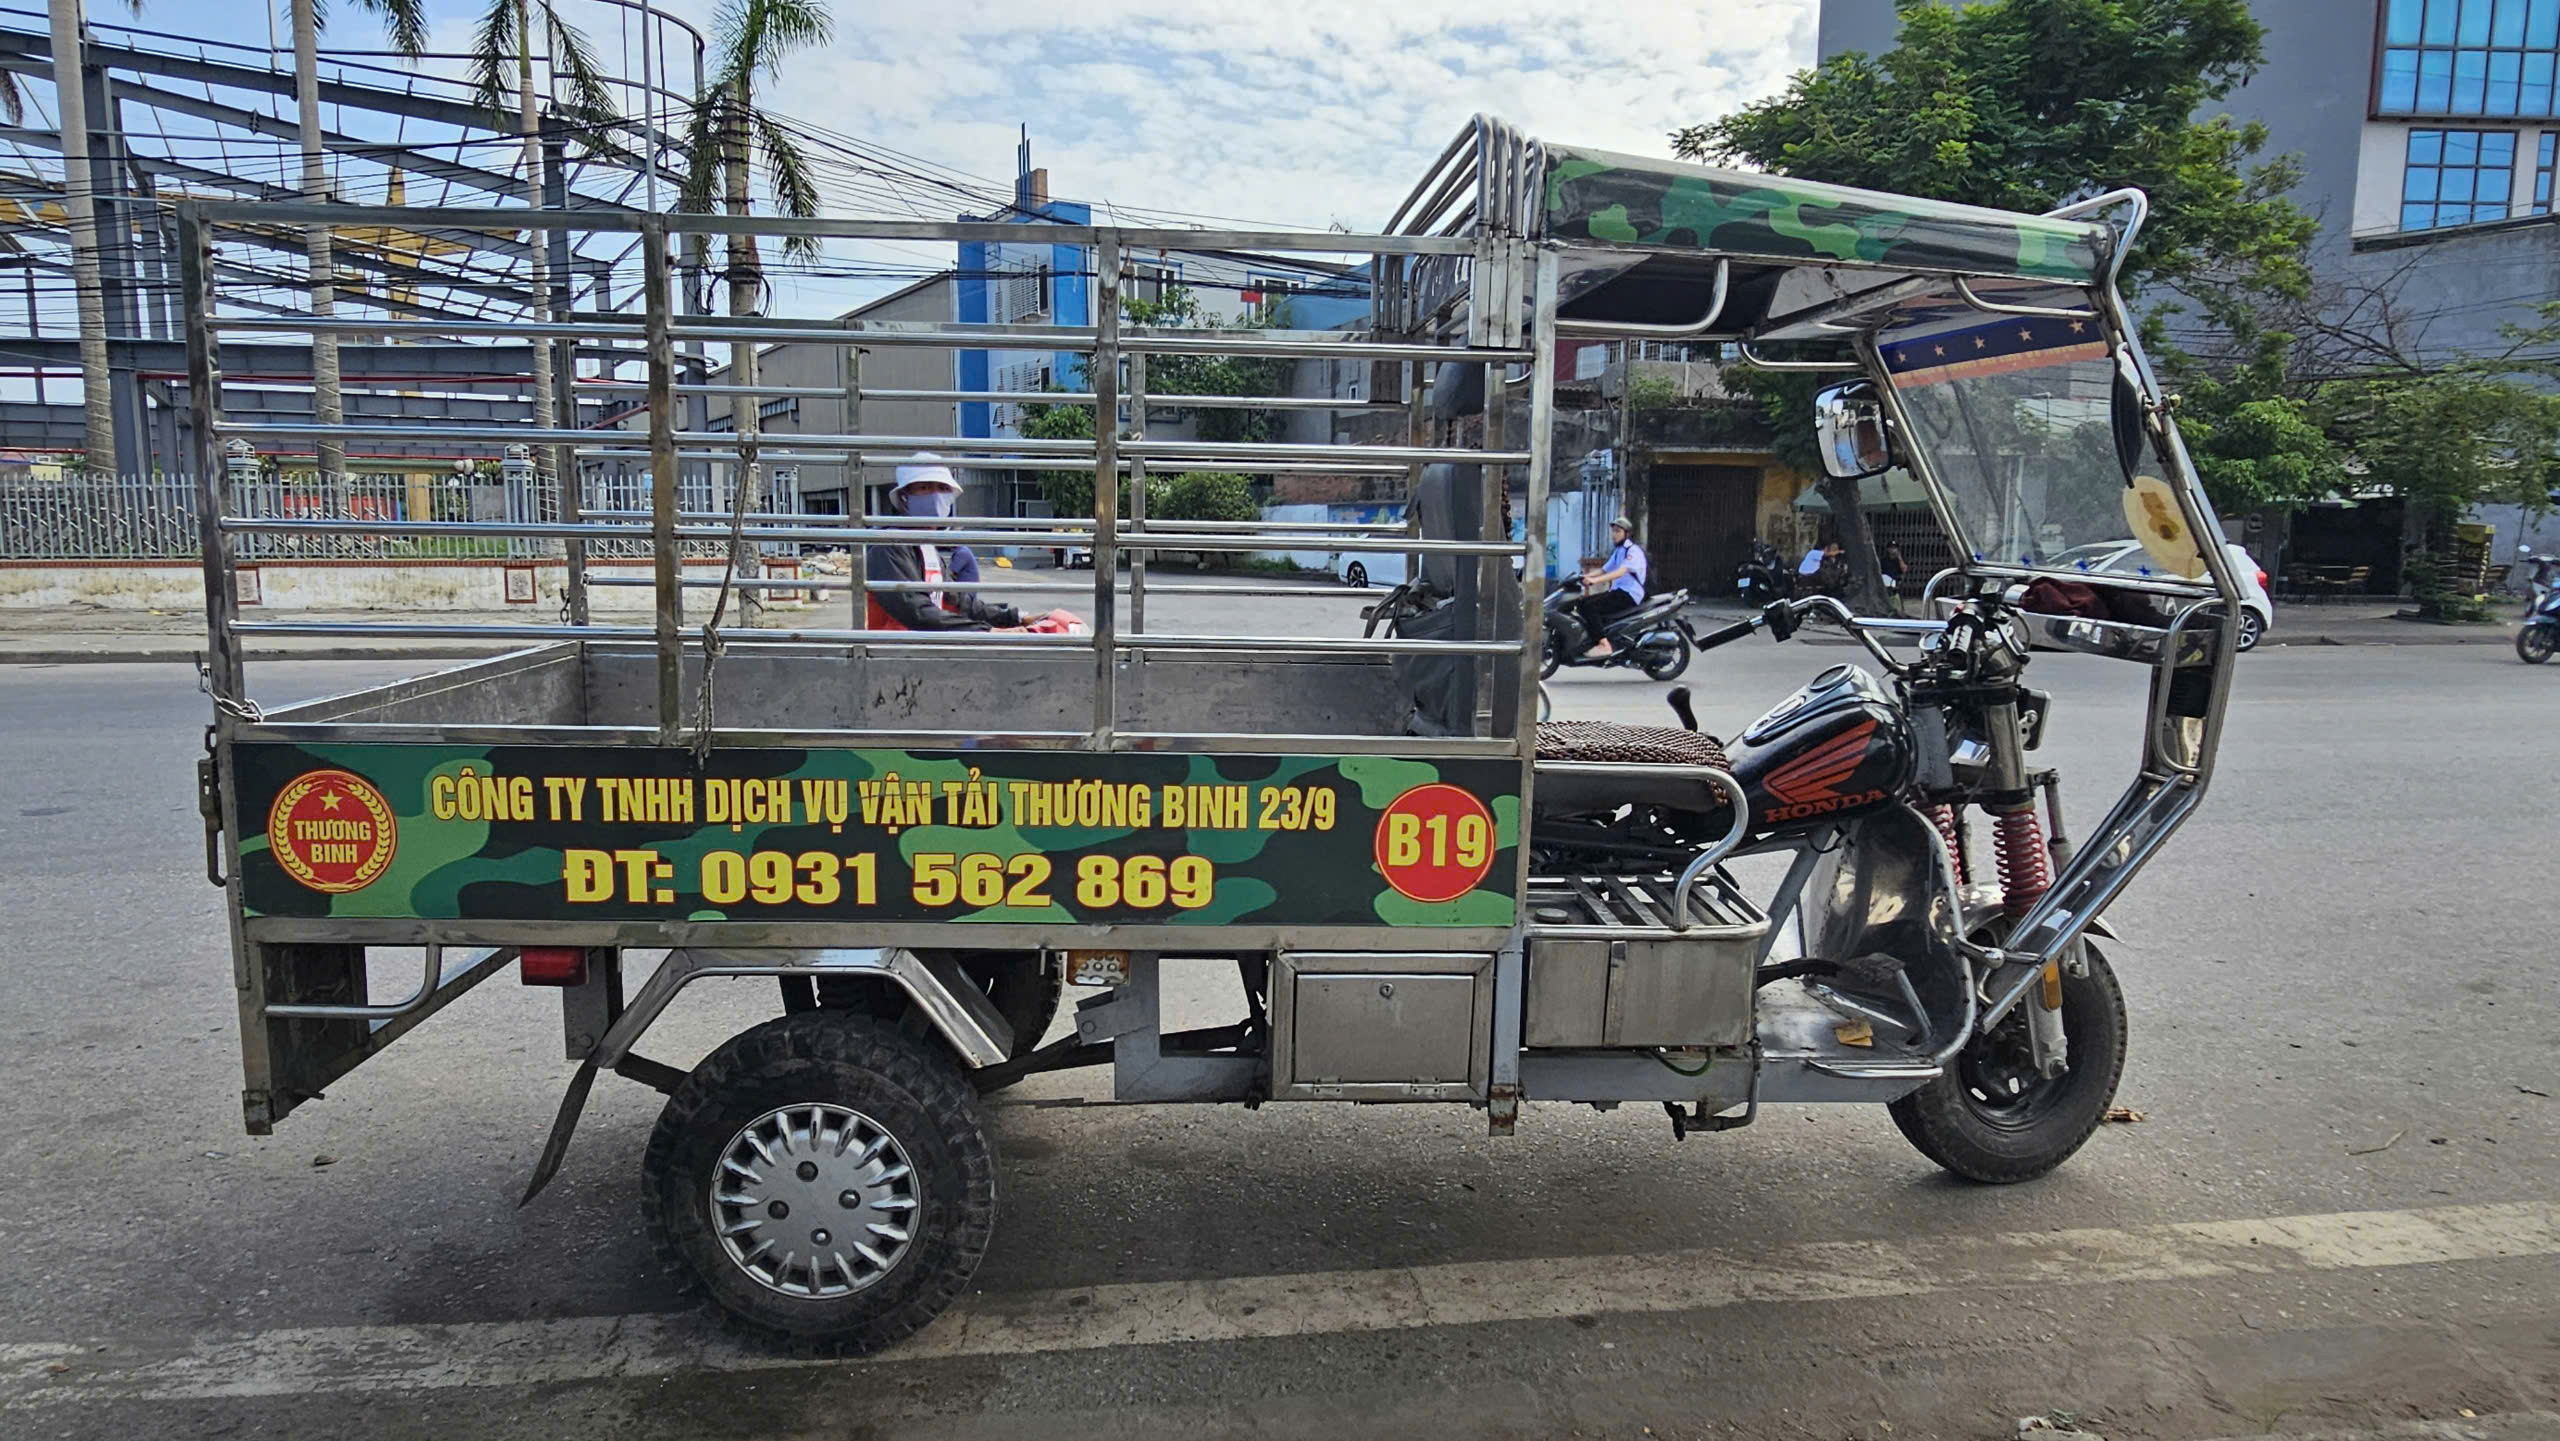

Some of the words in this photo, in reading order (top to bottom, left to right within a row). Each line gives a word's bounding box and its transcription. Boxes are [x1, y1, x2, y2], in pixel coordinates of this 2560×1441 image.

[431, 766, 536, 822] CÔNG
[542, 776, 586, 822] TY
[595, 777, 695, 824] TNHH
[704, 777, 792, 833] DỊCH
[800, 778, 849, 833] VỤ
[858, 771, 933, 834] VẬN
[942, 766, 999, 826] TẢI
[1008, 777, 1152, 829] THƯƠNG
[1161, 784, 1249, 830] BINH
[1257, 785, 1337, 832] 23/9
[1765, 789, 1886, 823] HONDA
[294, 818, 372, 841] THƯƠNG
[1386, 812, 1488, 869] B19
[310, 843, 358, 864] BINH
[562, 848, 674, 904] ĐT:
[700, 849, 877, 906] 0931
[911, 852, 1052, 907] 562
[1075, 853, 1214, 909] 869
